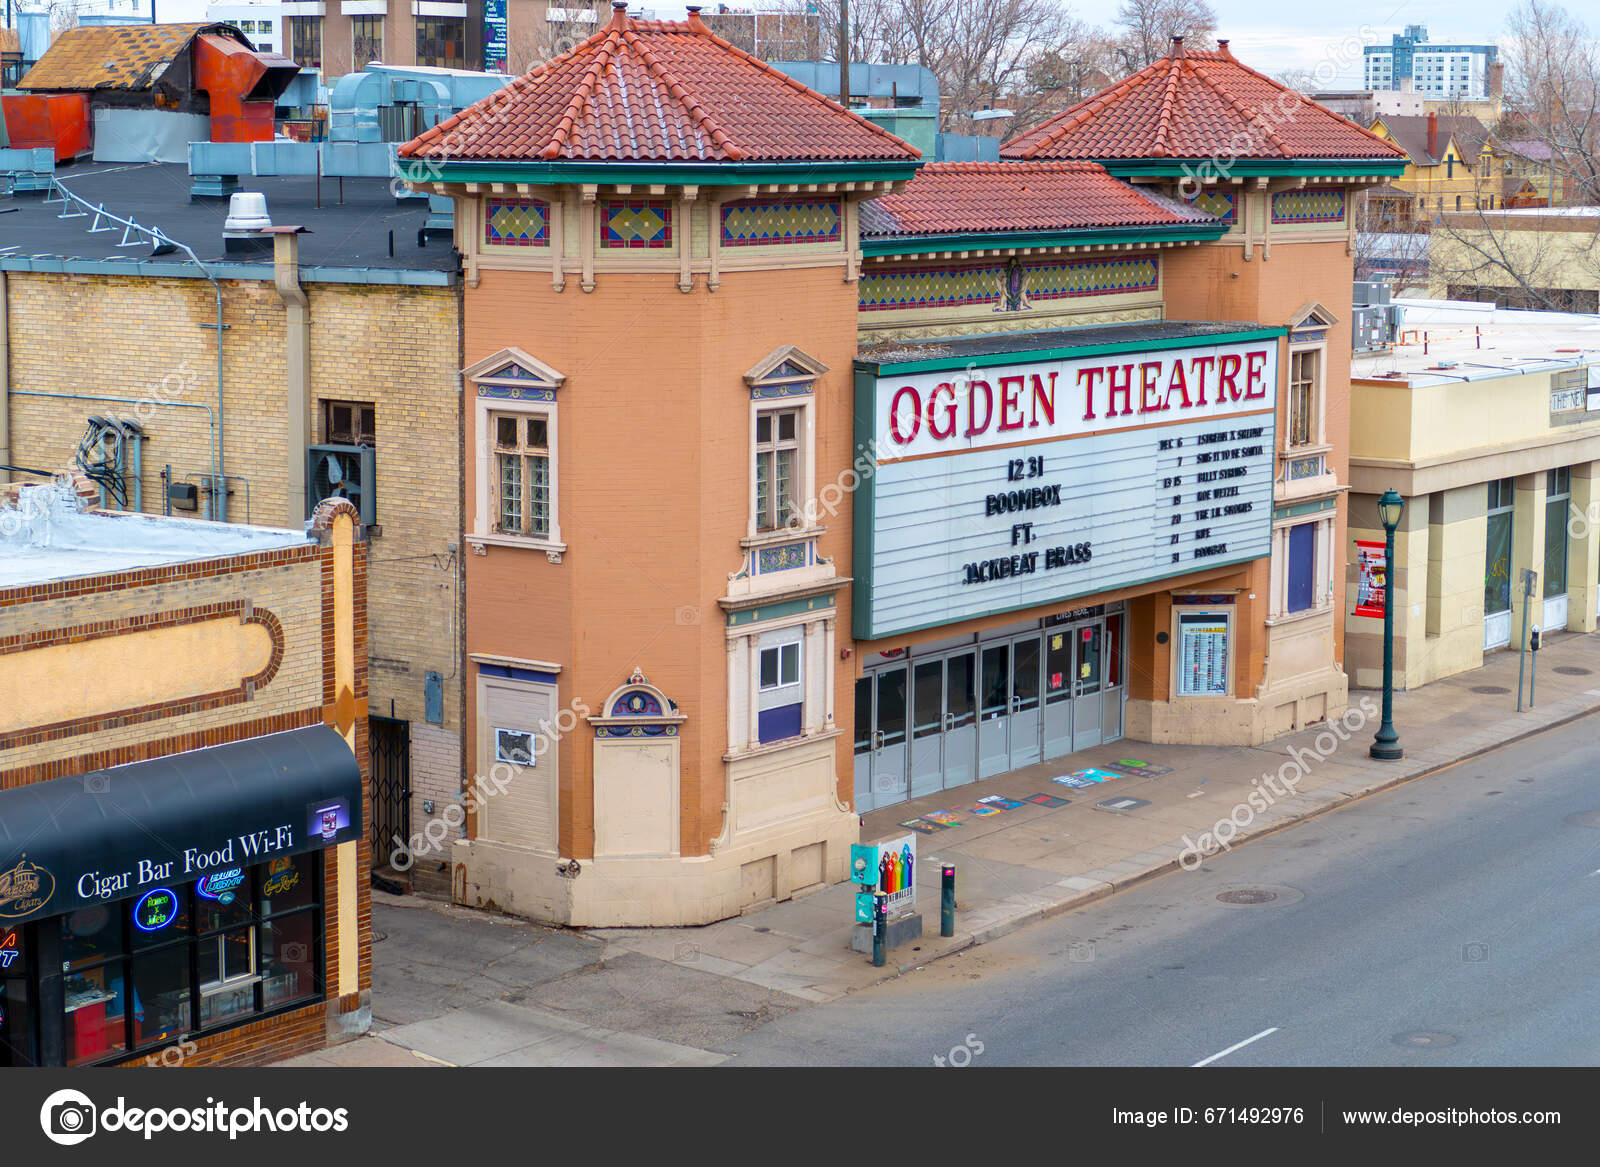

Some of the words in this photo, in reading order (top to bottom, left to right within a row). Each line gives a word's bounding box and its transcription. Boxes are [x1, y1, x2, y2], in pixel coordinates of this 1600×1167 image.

[889, 371, 1059, 445] OGDEN
[1077, 351, 1267, 420] THEATRE
[1177, 437, 1183, 448] 6
[1008, 458, 1025, 482] 12
[1027, 455, 1044, 478] 31
[1177, 456, 1183, 467] 7
[1197, 470, 1219, 483] BILLY
[985, 484, 1062, 517] BOOMBOX
[1195, 509, 1209, 521] THE
[1011, 521, 1037, 546] FT.
[962, 551, 1040, 585] JACKBEAT
[1045, 541, 1092, 570] BRASS
[77, 868, 132, 899] Cigar
[137, 860, 174, 885] Bar
[183, 839, 234, 873] Food
[239, 824, 294, 858] Wi-Fi
